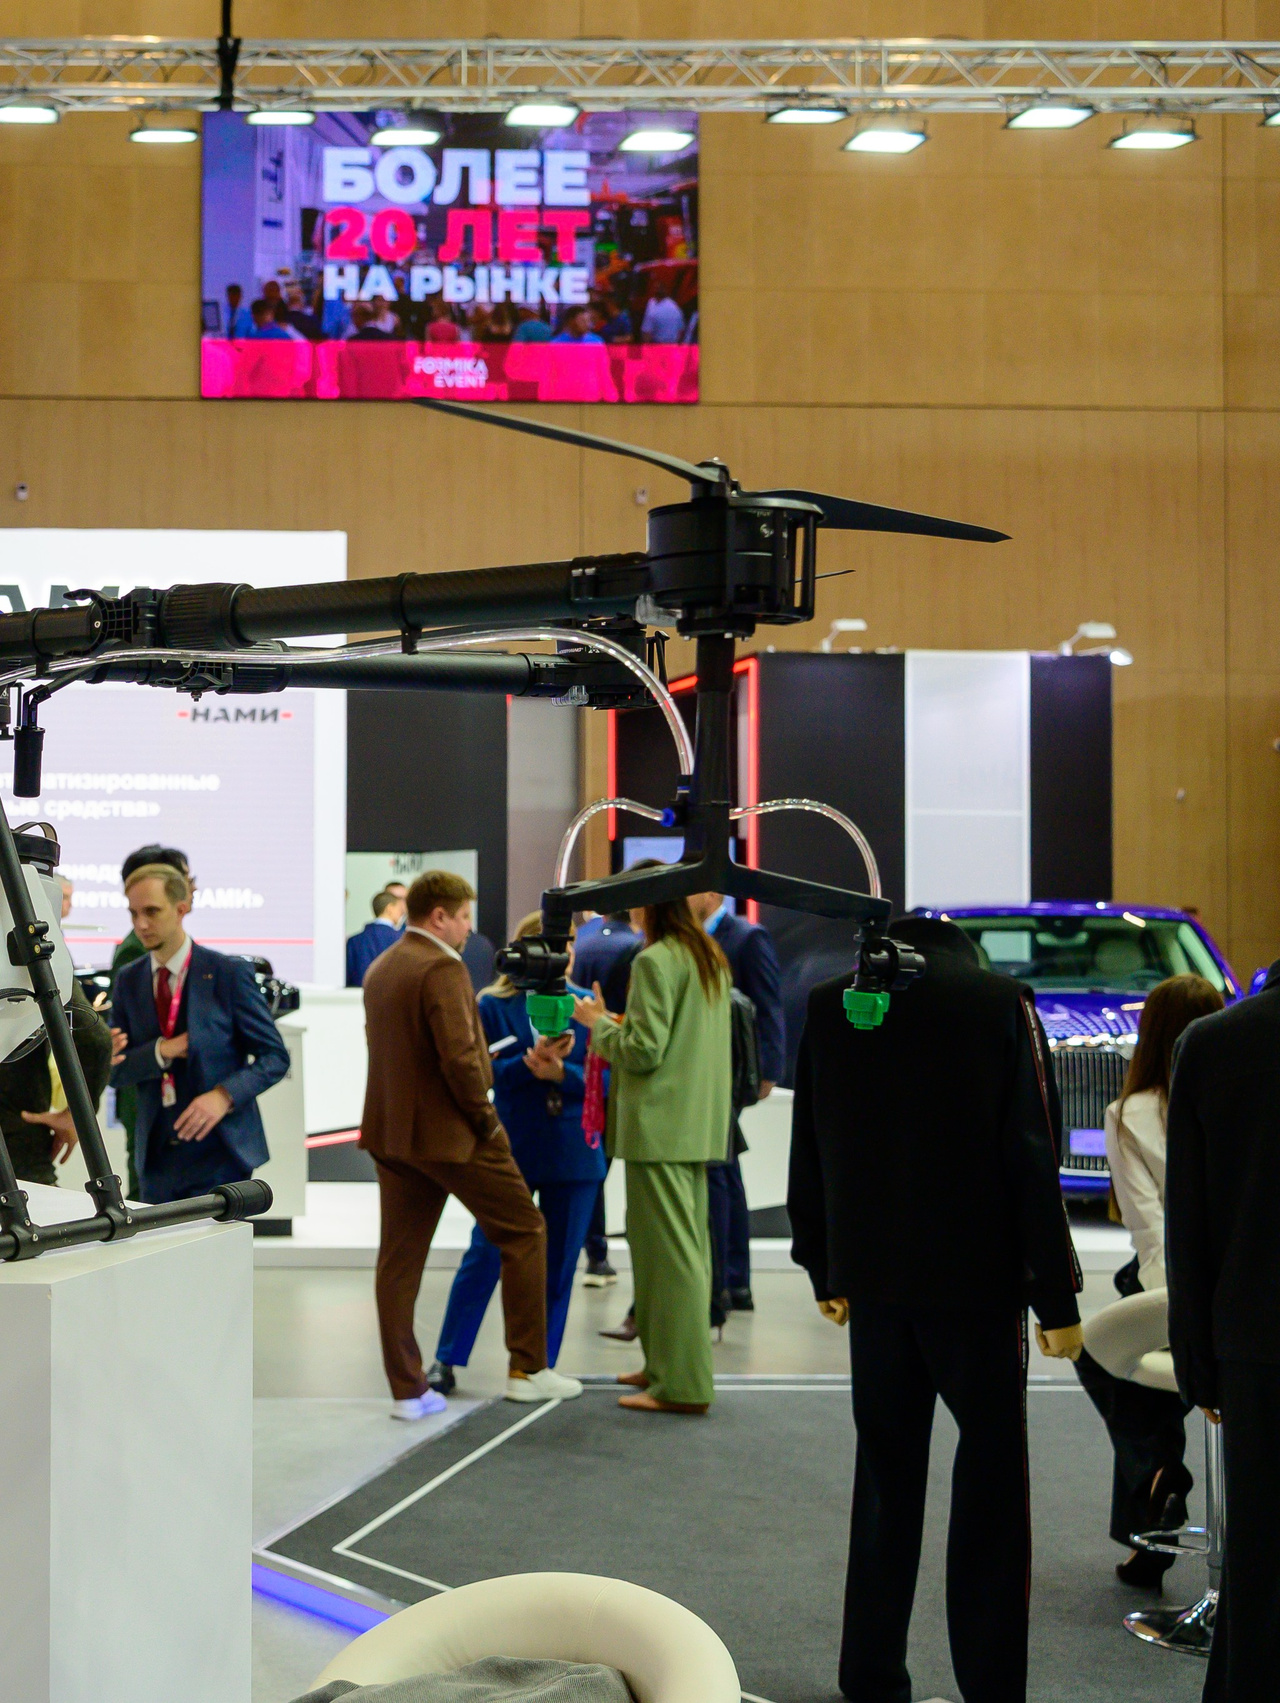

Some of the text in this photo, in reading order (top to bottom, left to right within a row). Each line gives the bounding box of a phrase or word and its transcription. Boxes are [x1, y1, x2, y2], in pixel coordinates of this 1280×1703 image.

[323, 146, 591, 206] БОЛЕЕ
[325, 206, 590, 263] 20 ЛЕТ
[323, 264, 590, 304] НА РЫНКЕ
[434, 374, 487, 388] EVENT
[191, 707, 280, 723] НАМИ
[44, 799, 161, 821] средства»
